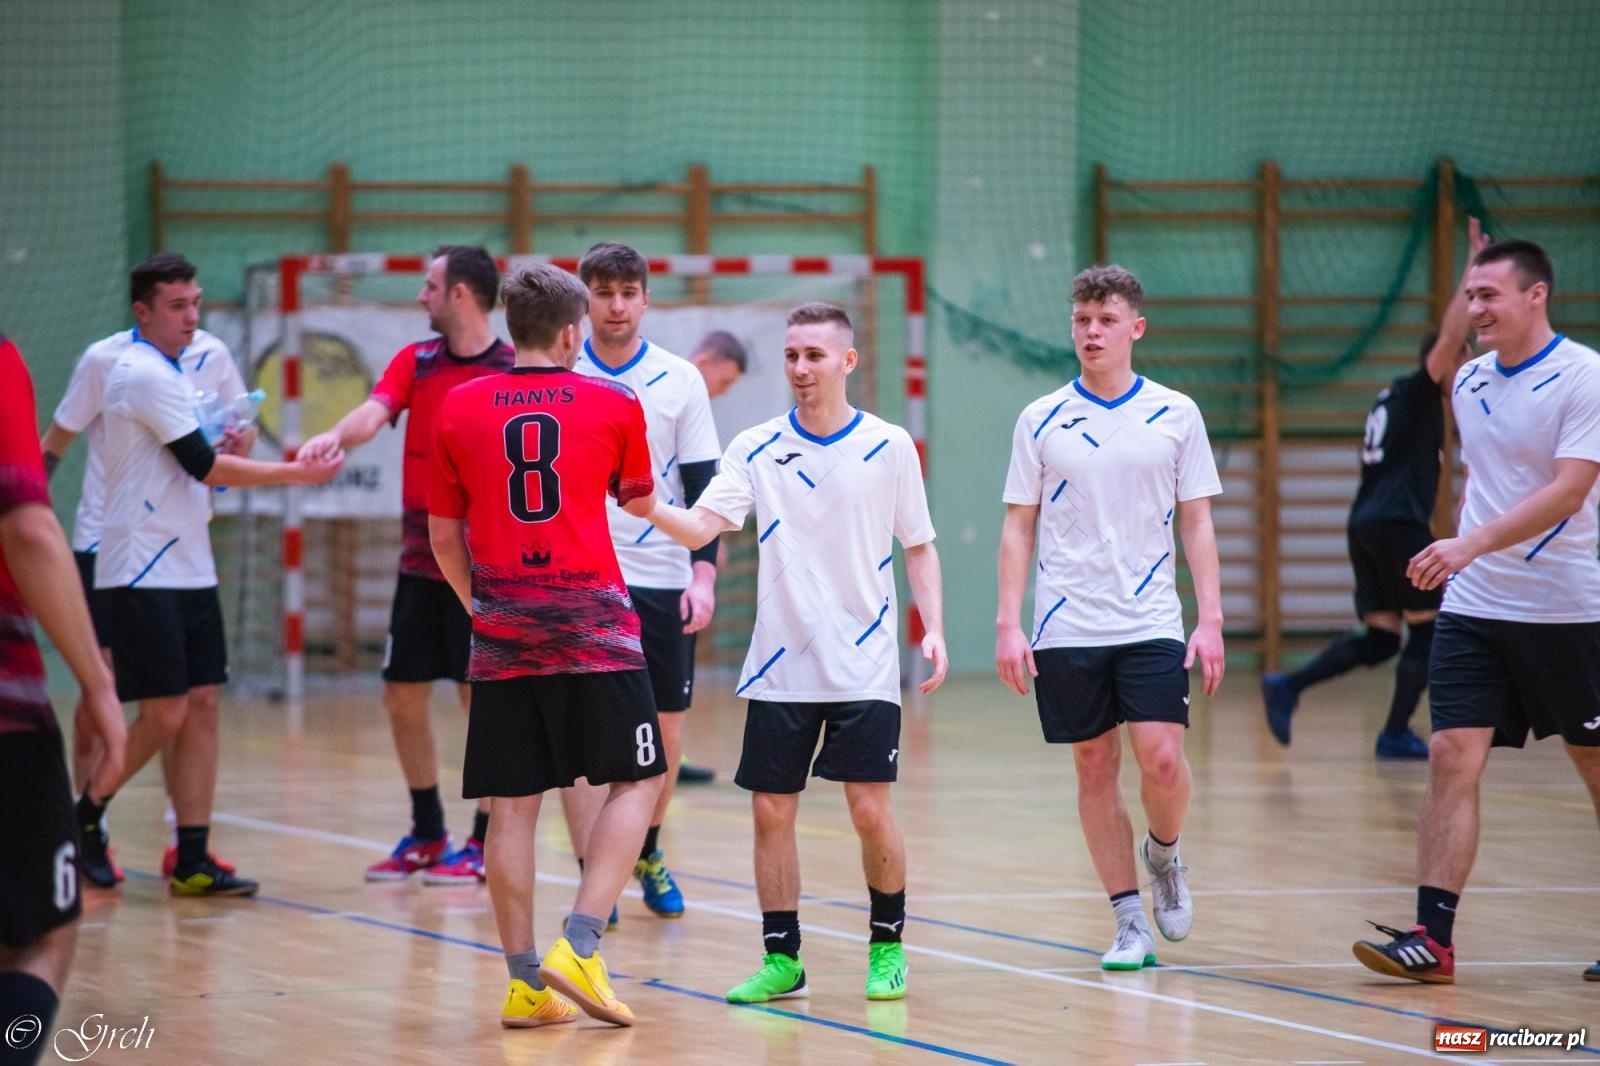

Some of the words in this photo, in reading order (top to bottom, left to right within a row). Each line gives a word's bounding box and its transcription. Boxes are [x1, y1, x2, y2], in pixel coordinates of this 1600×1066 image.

[494, 387, 575, 407] HANYS
[503, 412, 561, 524] 8
[635, 722, 656, 767] 8
[54, 840, 77, 911] 6
